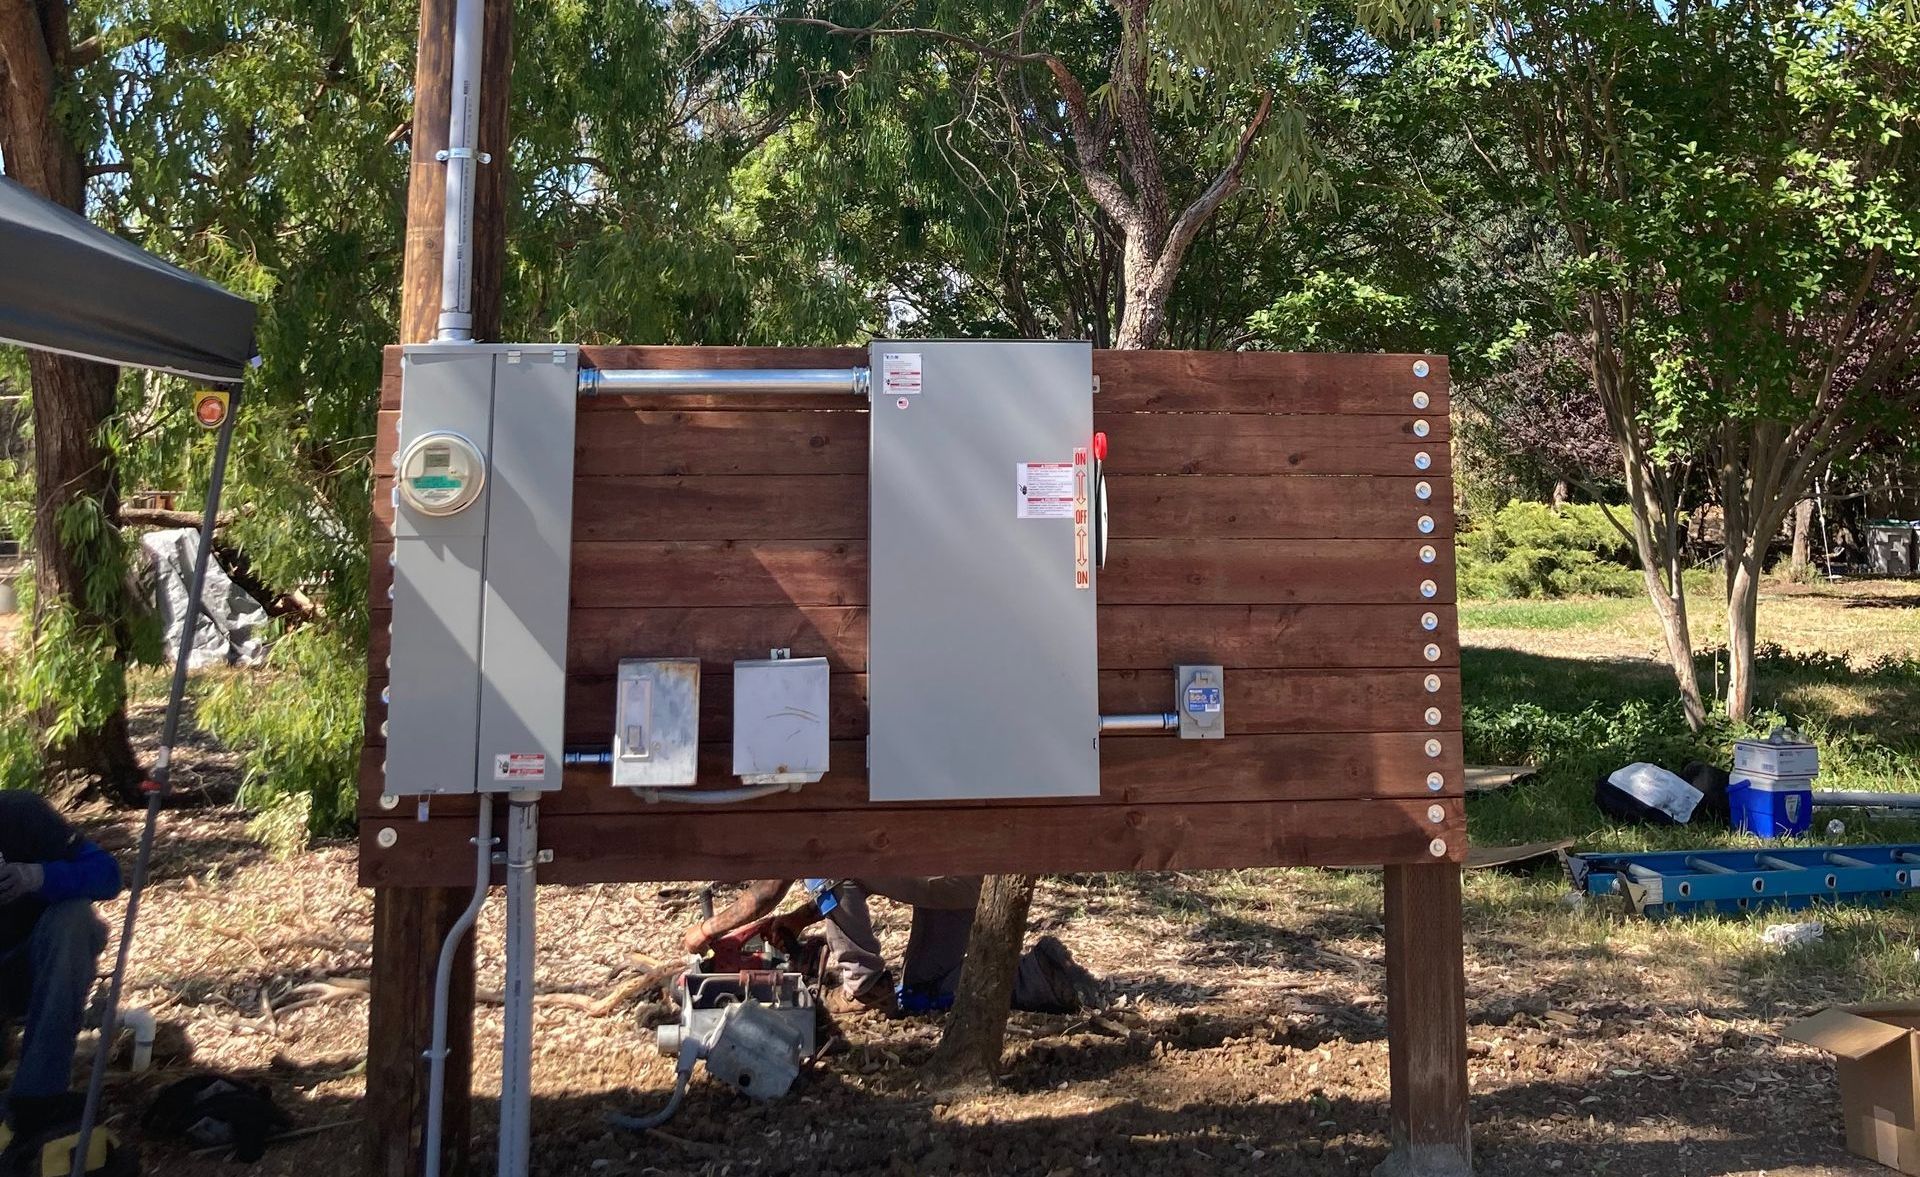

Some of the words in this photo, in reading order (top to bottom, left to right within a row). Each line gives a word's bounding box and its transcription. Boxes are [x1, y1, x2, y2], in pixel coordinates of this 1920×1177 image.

[1075, 452, 1086, 465] ON
[1076, 509, 1087, 524] OFF
[1077, 571, 1088, 584] ON
